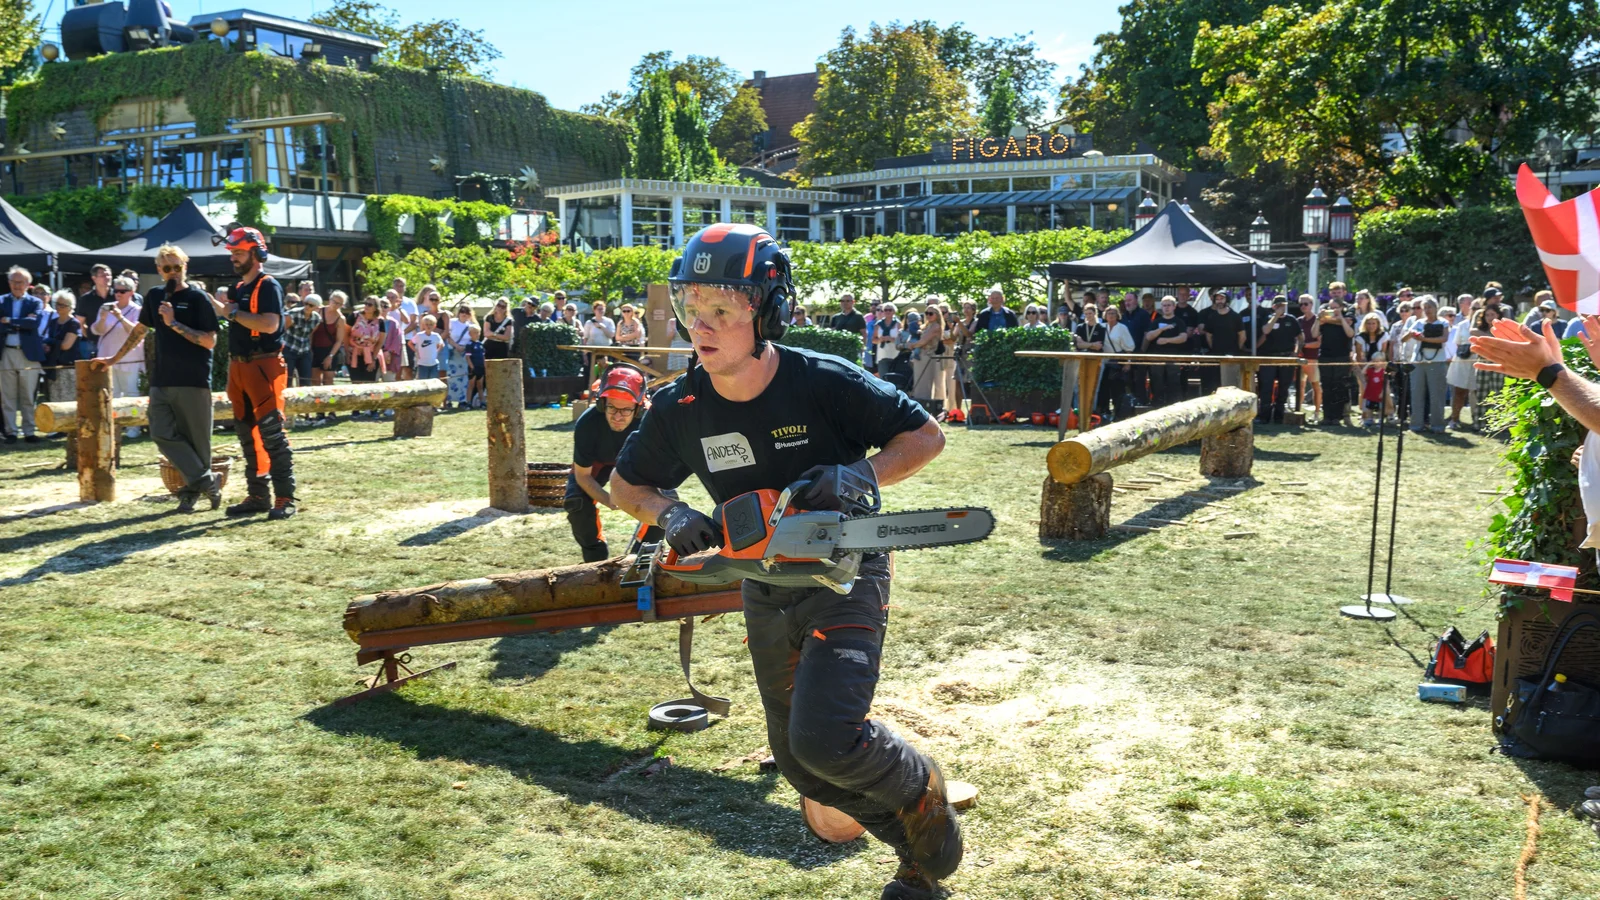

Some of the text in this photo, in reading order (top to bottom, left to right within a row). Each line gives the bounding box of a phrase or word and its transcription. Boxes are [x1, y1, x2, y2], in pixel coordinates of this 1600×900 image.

[952, 133, 1070, 160] FIGARO
[771, 425, 807, 438] TIVOLI
[781, 438, 809, 448] Husqvarna
[706, 443, 746, 460] ANDERS
[889, 524, 947, 536] Husqvarna
